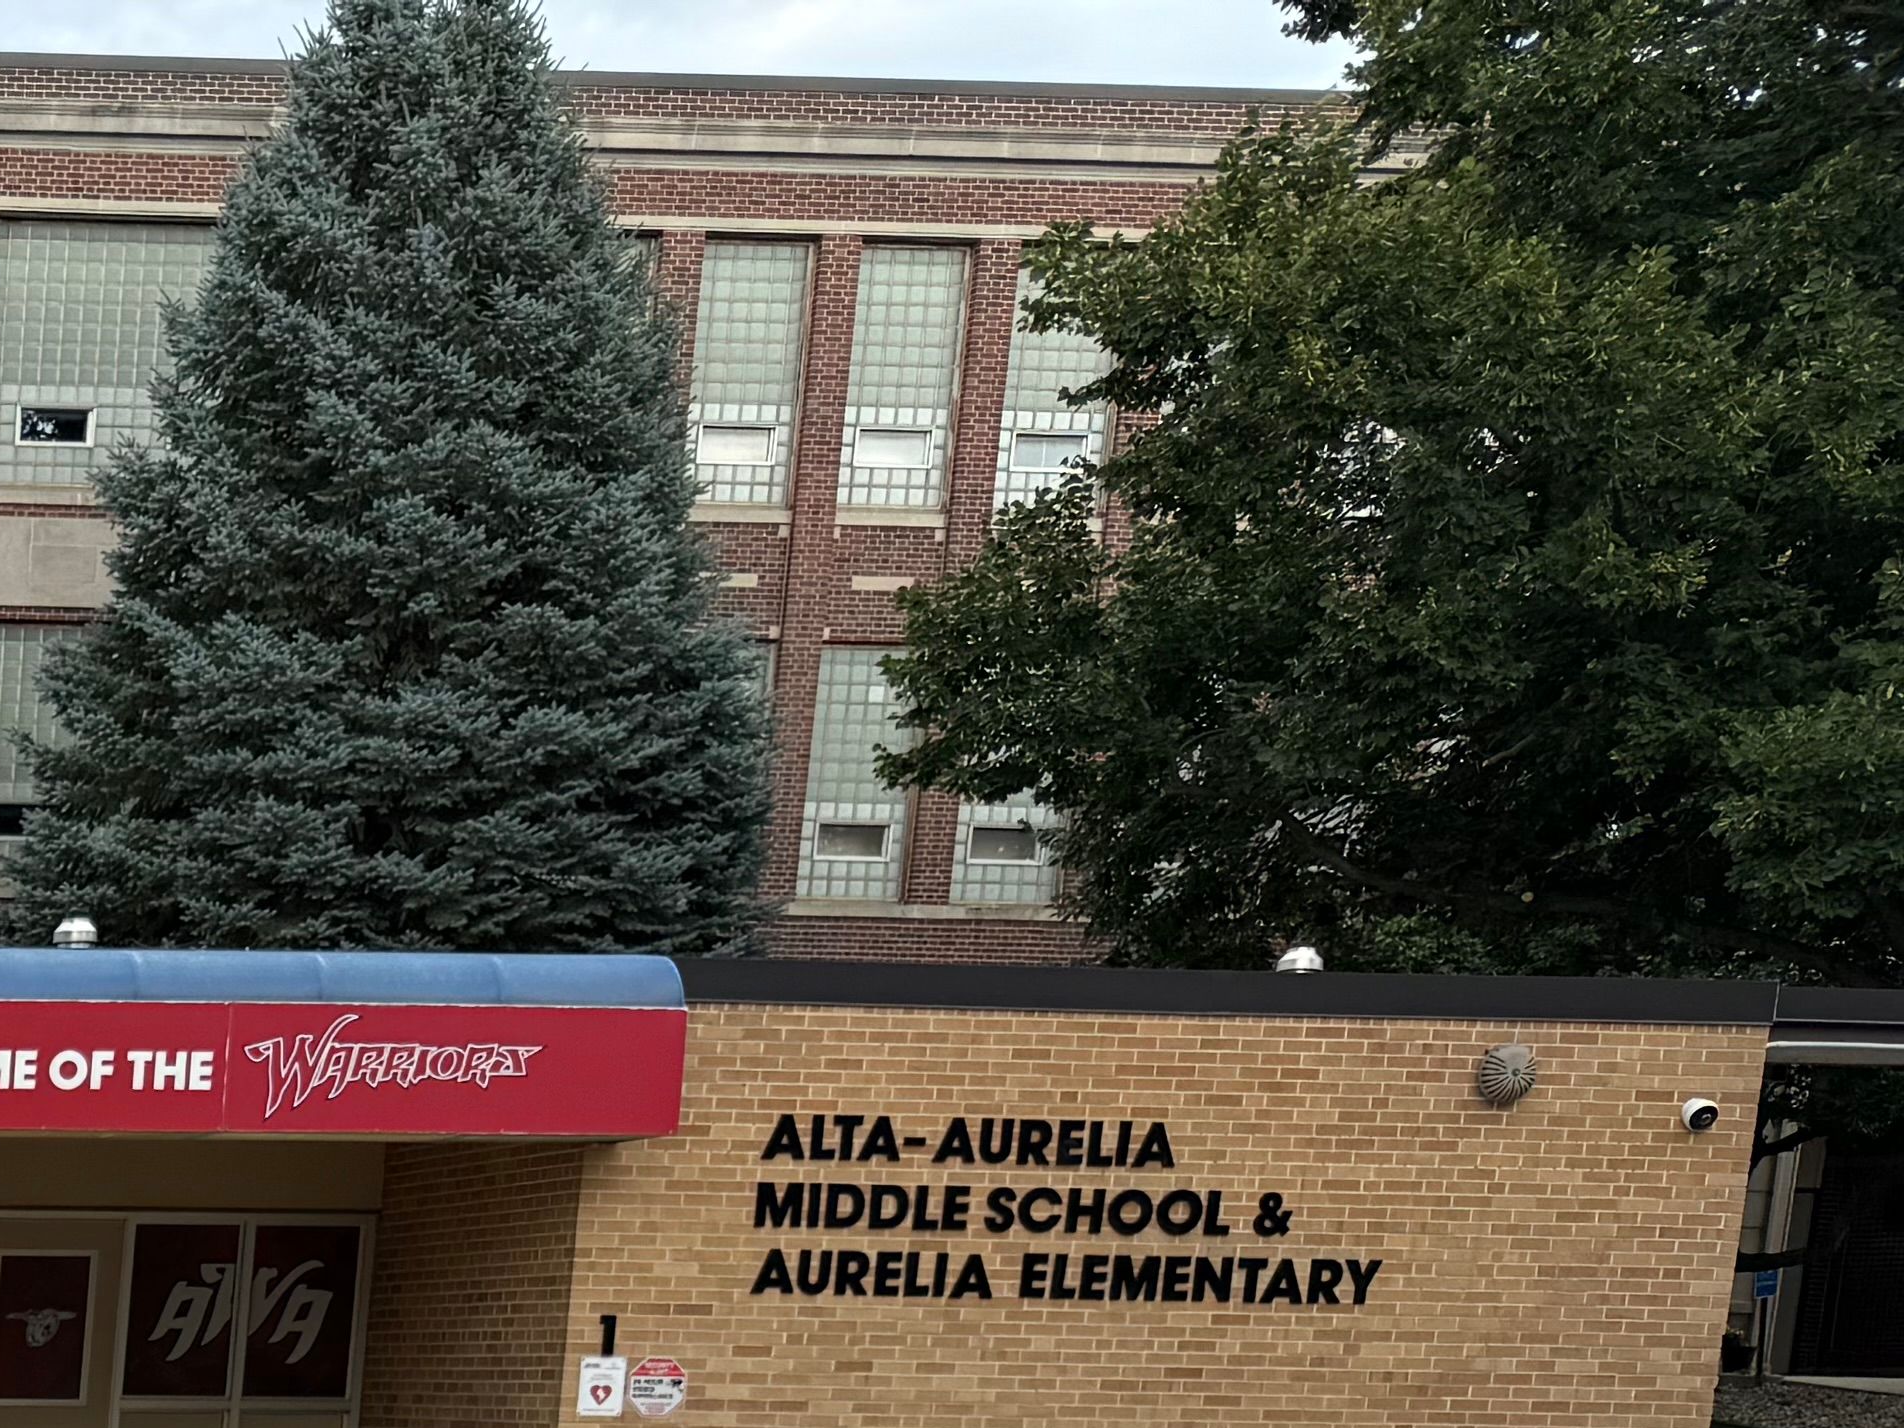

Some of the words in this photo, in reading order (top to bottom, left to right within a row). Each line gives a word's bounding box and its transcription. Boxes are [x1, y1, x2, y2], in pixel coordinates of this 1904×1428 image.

[48, 1049, 115, 1091] OF
[127, 1050, 214, 1091] THE
[760, 1114, 1176, 1169] ALTA-AURELIA
[753, 1182, 971, 1232] MIDDLE
[983, 1186, 1230, 1237] SCHOOL
[1252, 1191, 1294, 1238] &
[749, 1248, 993, 1300] AURELIA
[1019, 1253, 1384, 1305] ELEMENTARY
